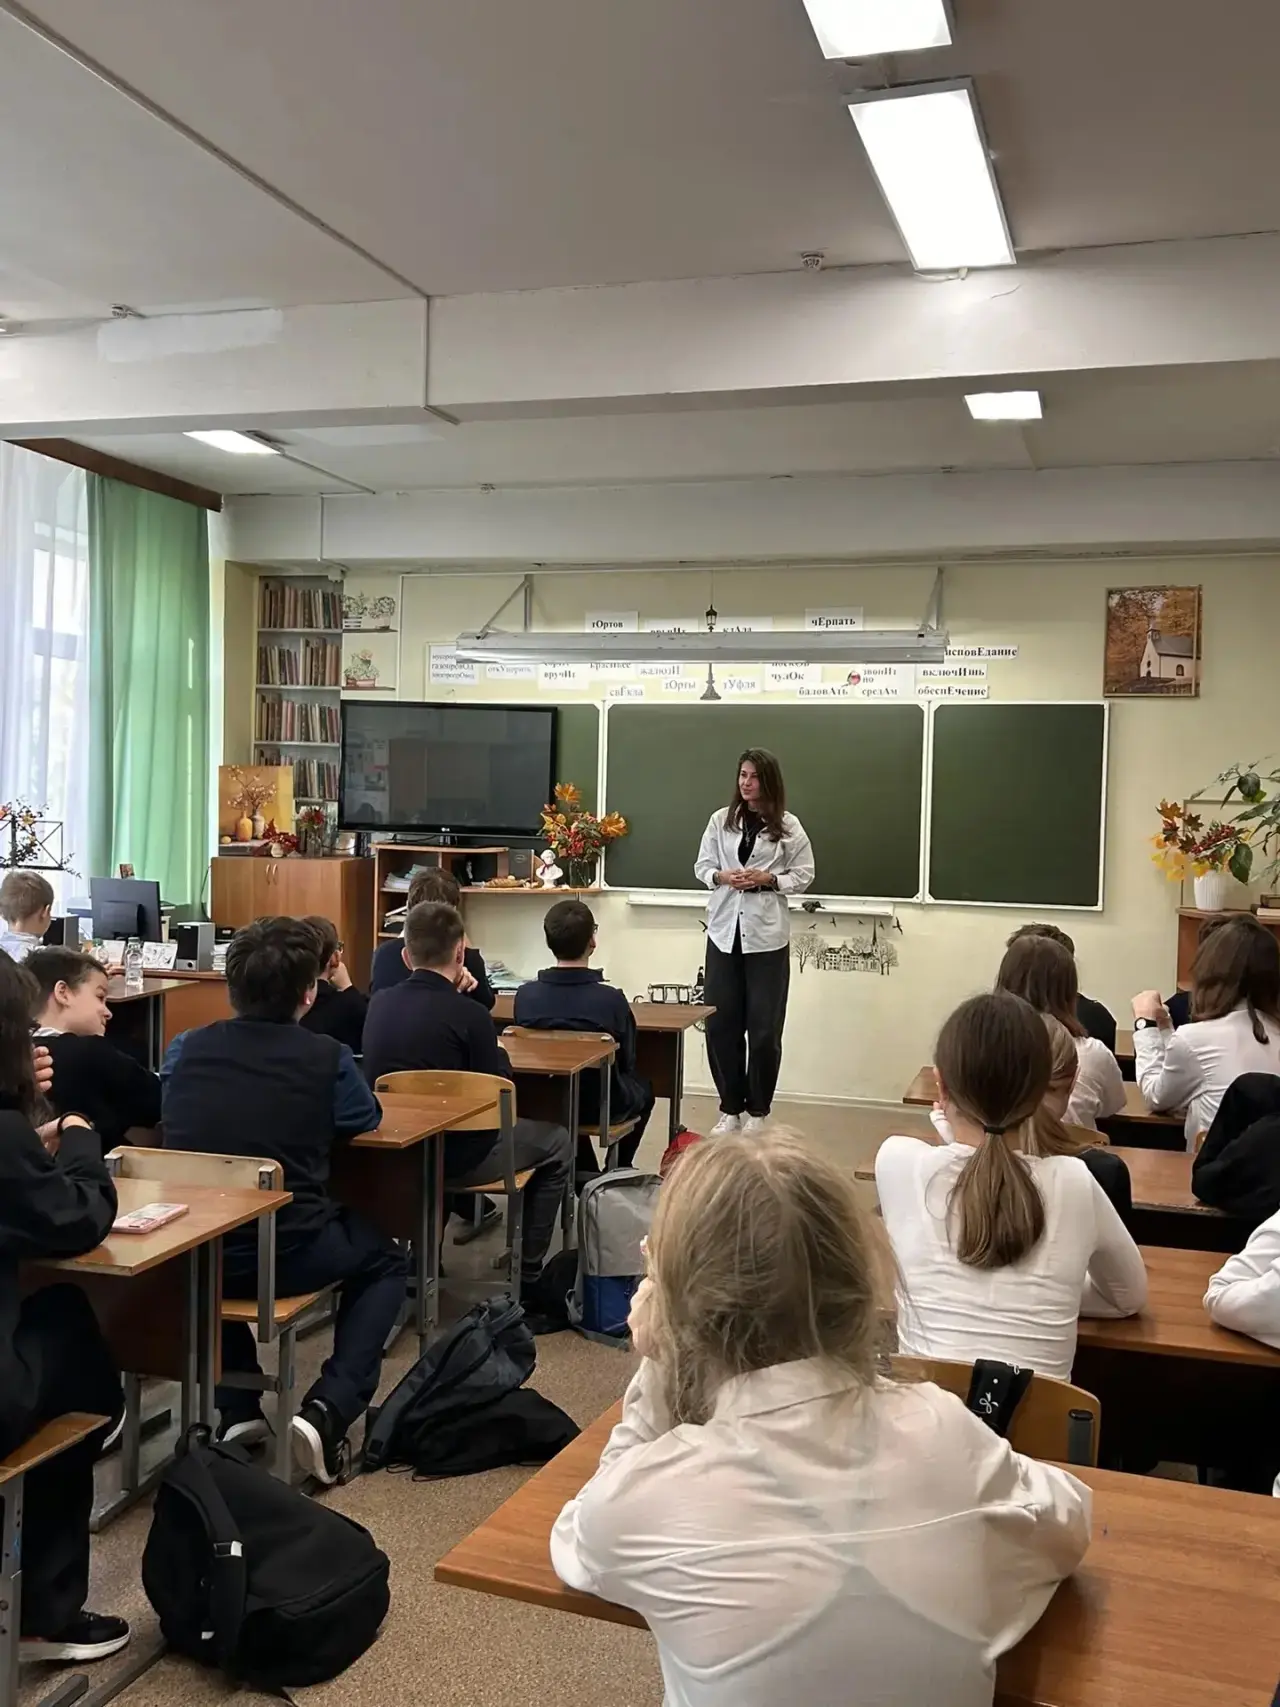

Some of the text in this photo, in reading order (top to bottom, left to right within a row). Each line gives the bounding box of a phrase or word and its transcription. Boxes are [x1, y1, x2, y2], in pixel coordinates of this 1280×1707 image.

[592, 620, 623, 630] тОртов
[811, 617, 856, 628] чЕрпать
[544, 670, 576, 680] вручИт
[771, 671, 805, 683] чулОк
[863, 667, 897, 676] звонИт
[922, 667, 985, 677] включИшь
[665, 679, 697, 692] тОрты
[723, 679, 756, 691] тУфля
[918, 685, 987, 696] обеспЕчение
[798, 686, 849, 696] баловАть
[862, 687, 898, 698] средАм
